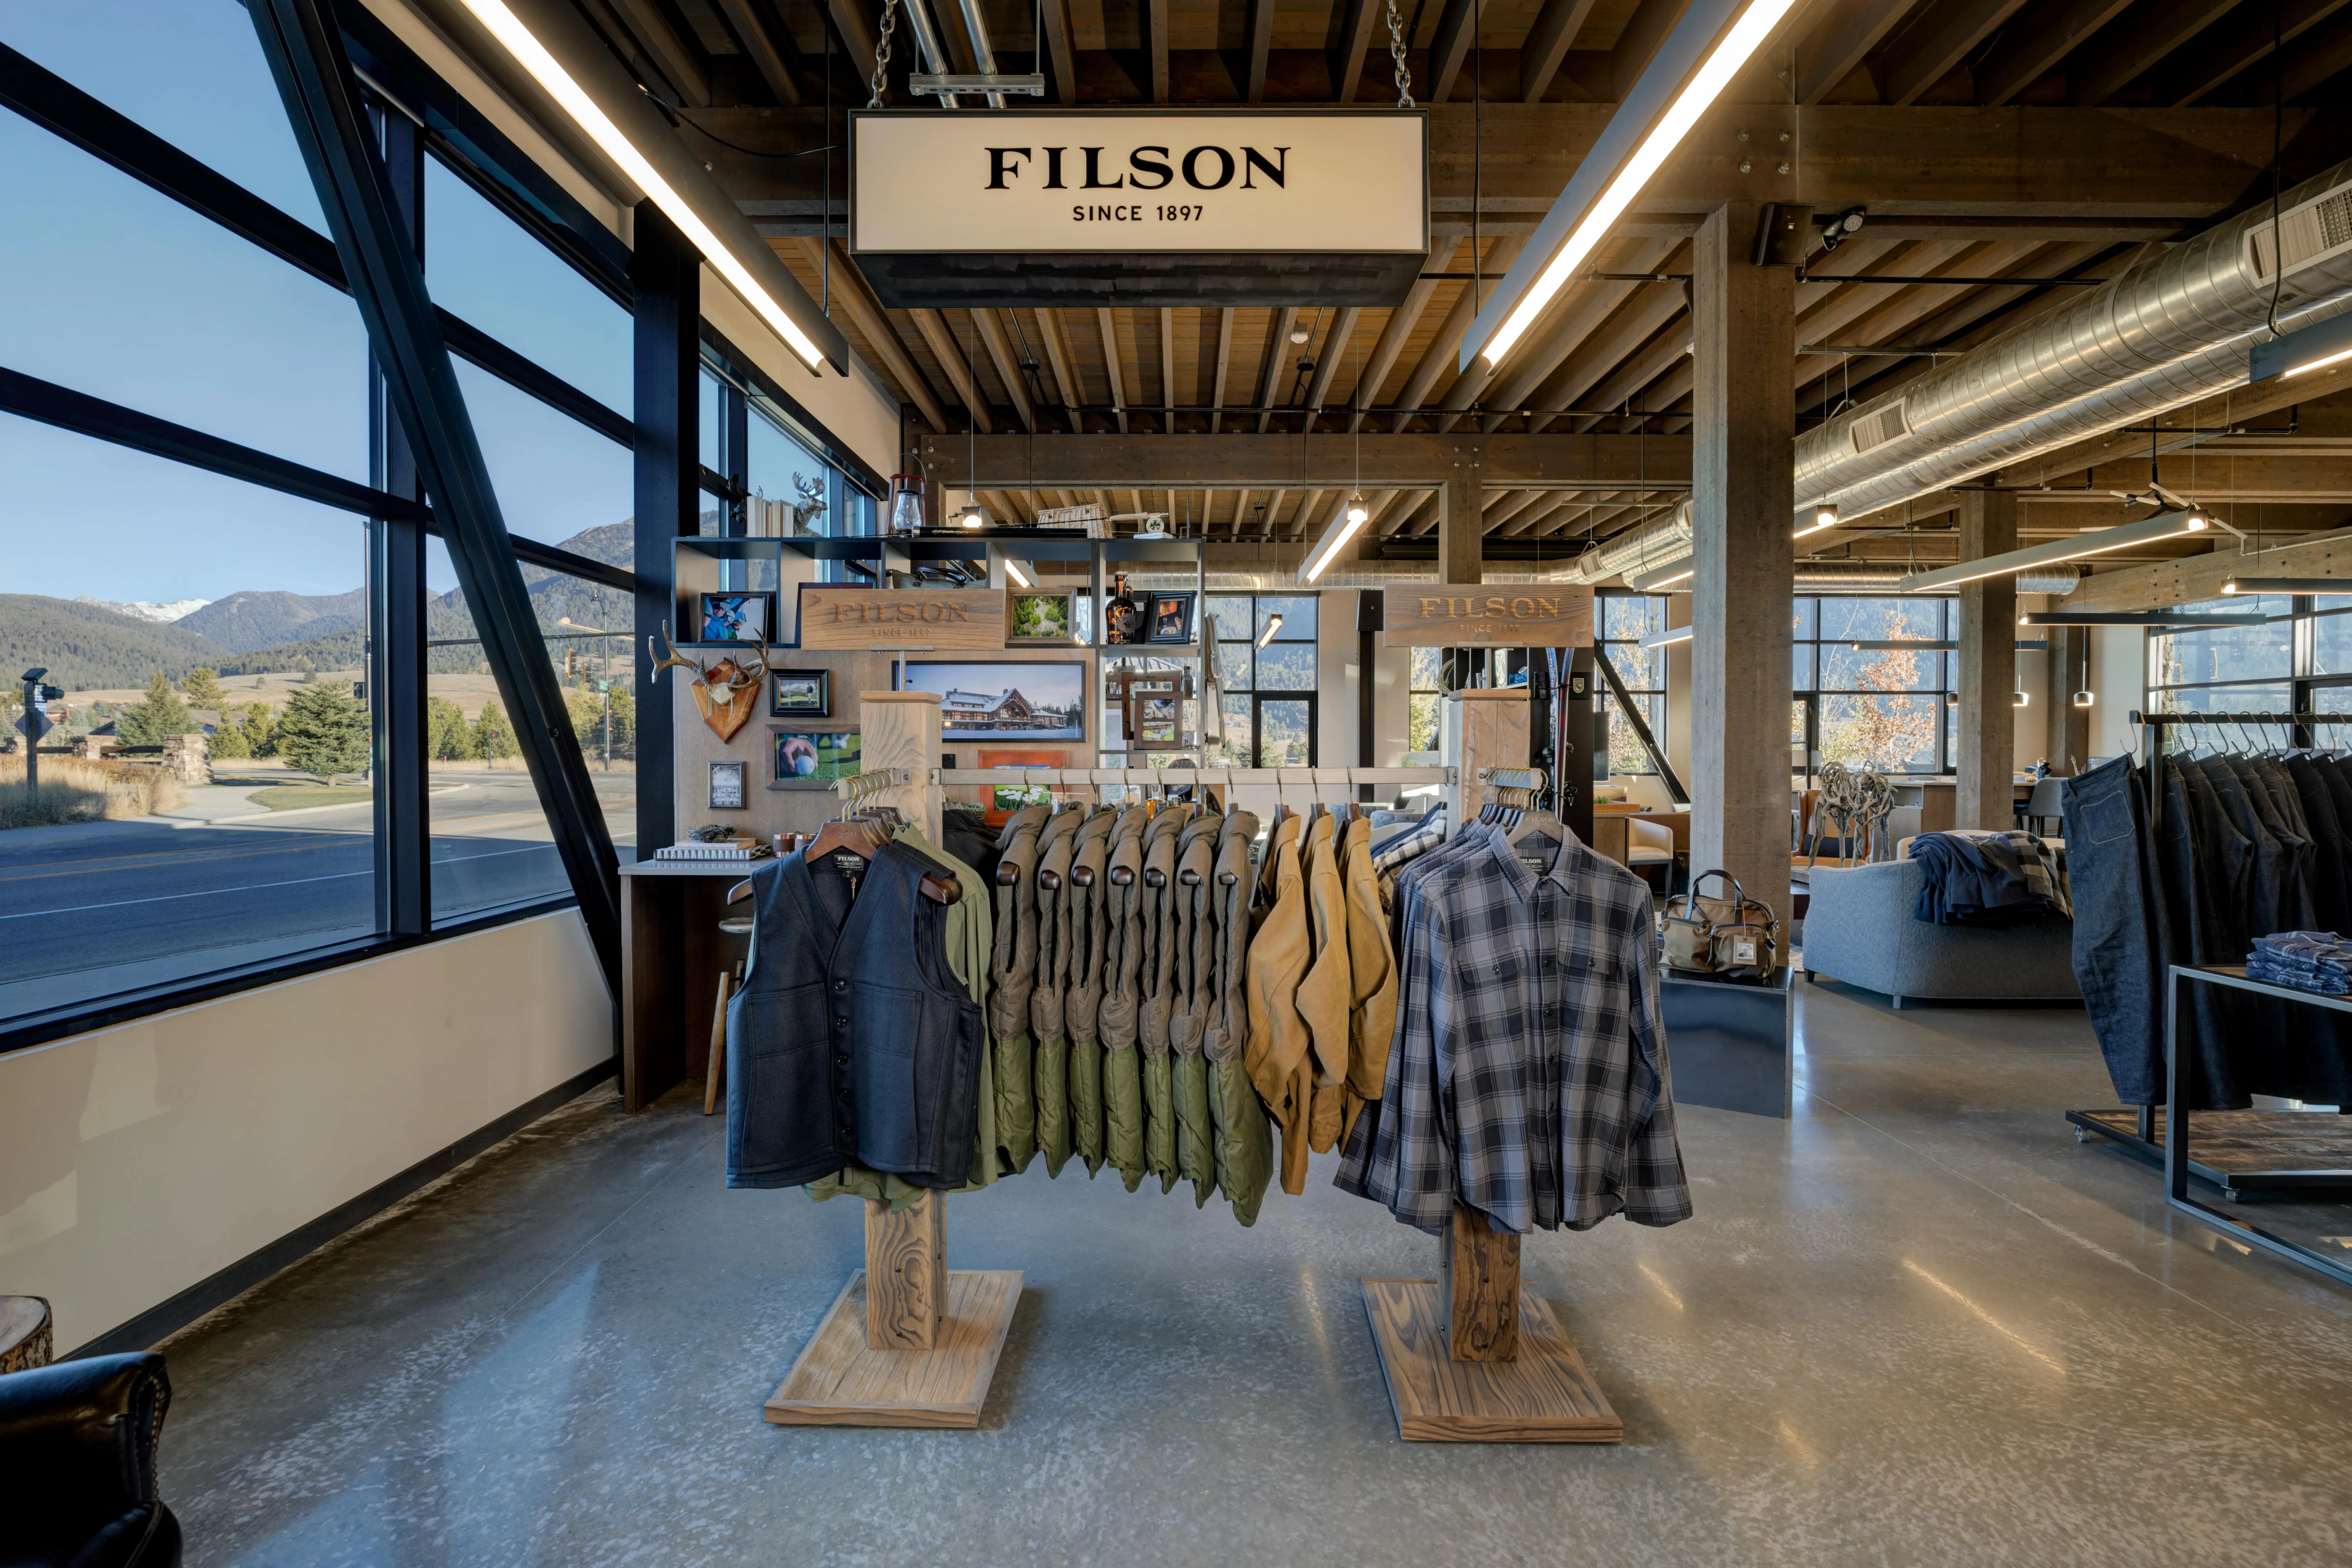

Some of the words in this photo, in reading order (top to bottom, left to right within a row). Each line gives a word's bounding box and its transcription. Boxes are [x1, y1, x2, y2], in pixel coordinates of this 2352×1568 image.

[984, 145, 1291, 190] FILSON
[1073, 206, 1142, 221] SINCE
[1156, 206, 1203, 221] 1897
[833, 602, 969, 623] FILSON
[1419, 597, 1561, 618] FILSON
[873, 628, 904, 637] SINCE
[910, 628, 931, 637] 1897
